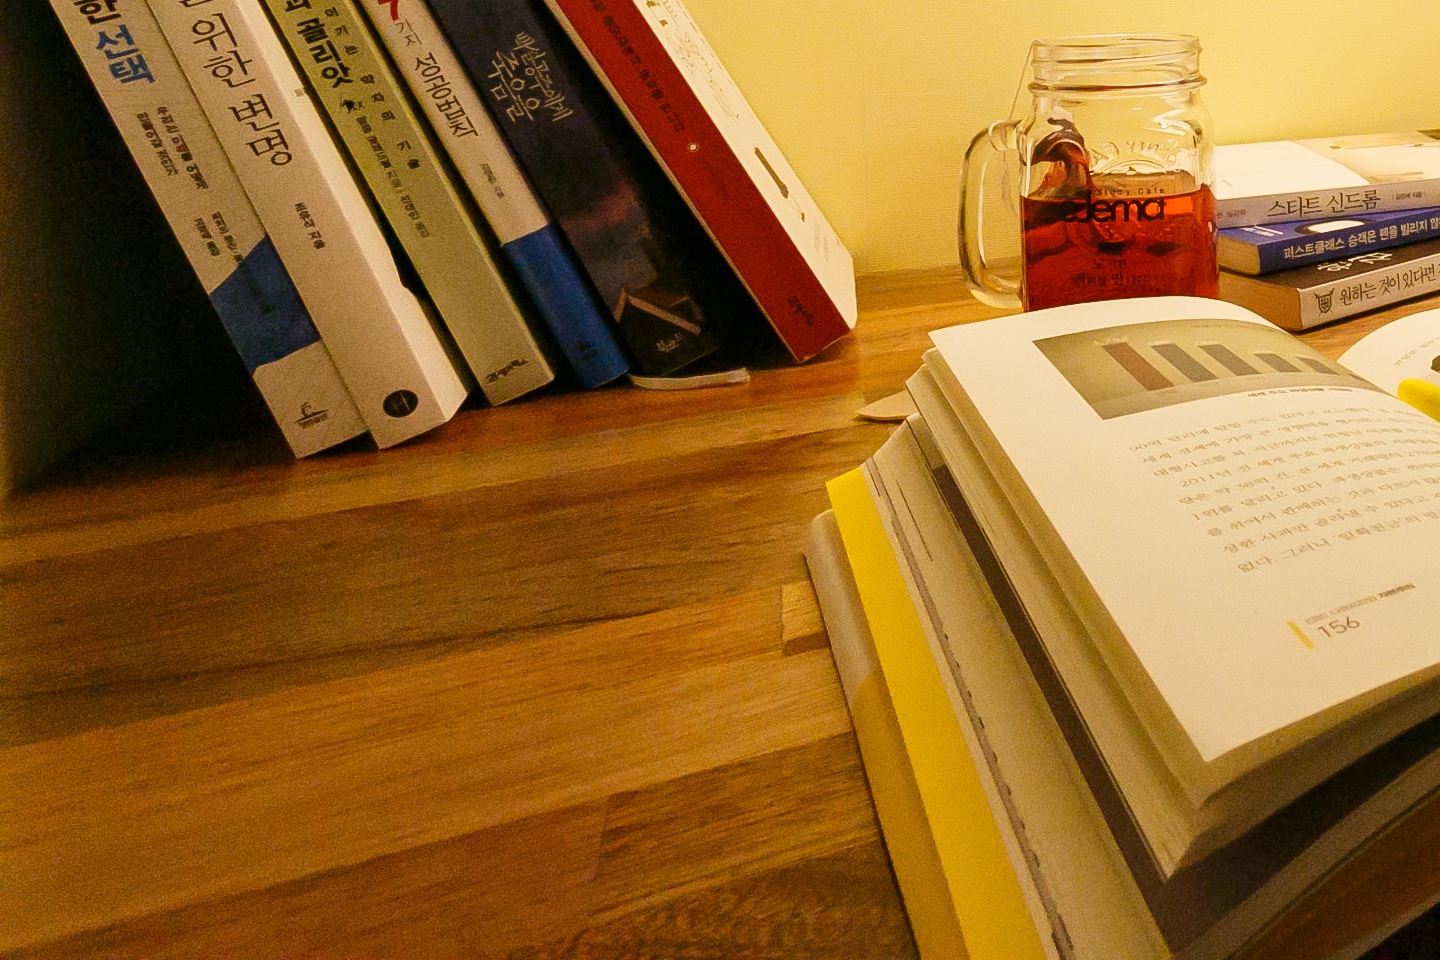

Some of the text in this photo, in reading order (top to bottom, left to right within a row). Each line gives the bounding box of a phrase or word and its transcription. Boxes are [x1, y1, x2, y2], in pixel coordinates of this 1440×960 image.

[95, 24, 156, 84] 선택
[296, 16, 354, 89] 골리앗
[192, 12, 256, 89] 위한
[228, 93, 293, 166] 변명
[415, 52, 479, 138] 성공법칙
[1268, 196, 1323, 217] 스타트
[1326, 189, 1381, 213] 신드롬
[1283, 237, 1345, 259] 퍼스트클래스
[1348, 229, 1376, 247] 승객은
[1379, 225, 1398, 240] 펜을
[1401, 219, 1428, 237] 빌리지
[1339, 282, 1376, 306] 원하는
[1379, 273, 1400, 295] 것이
[1402, 265, 1436, 288] 있다면
[1182, 468, 1232, 487] 2011년
[1317, 616, 1361, 638] 156
